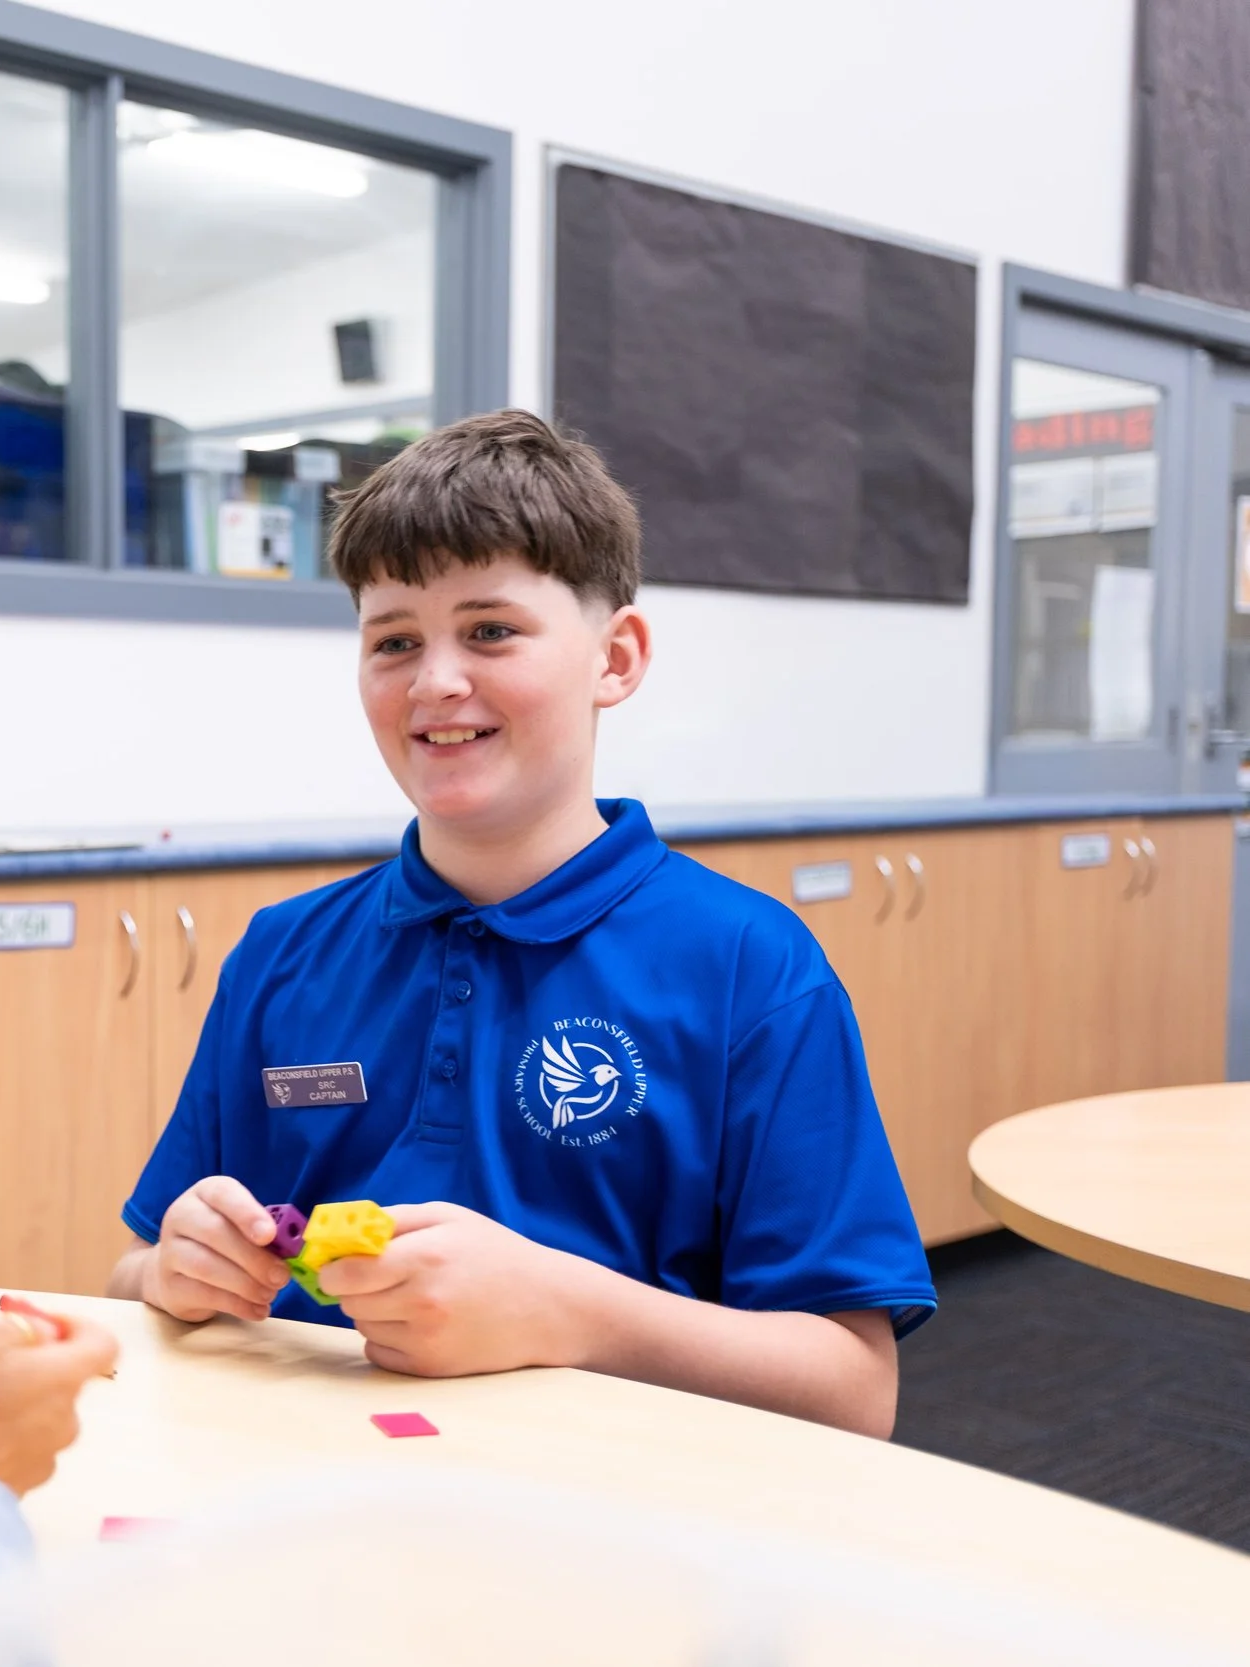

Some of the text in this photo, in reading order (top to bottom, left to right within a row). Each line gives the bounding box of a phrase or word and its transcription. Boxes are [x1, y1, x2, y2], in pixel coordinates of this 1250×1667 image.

[267, 1067, 356, 1081] BEACONSFIELD UPPER P.S.
[514, 1039, 540, 1094] PRIMARY
[553, 1016, 648, 1117] BEACONSFIELD UPPER
[309, 1090, 347, 1101] CAPTAIN
[317, 1080, 336, 1090] SRC
[516, 1096, 553, 1141] SCHOOL
[588, 1125, 618, 1146] 1884
